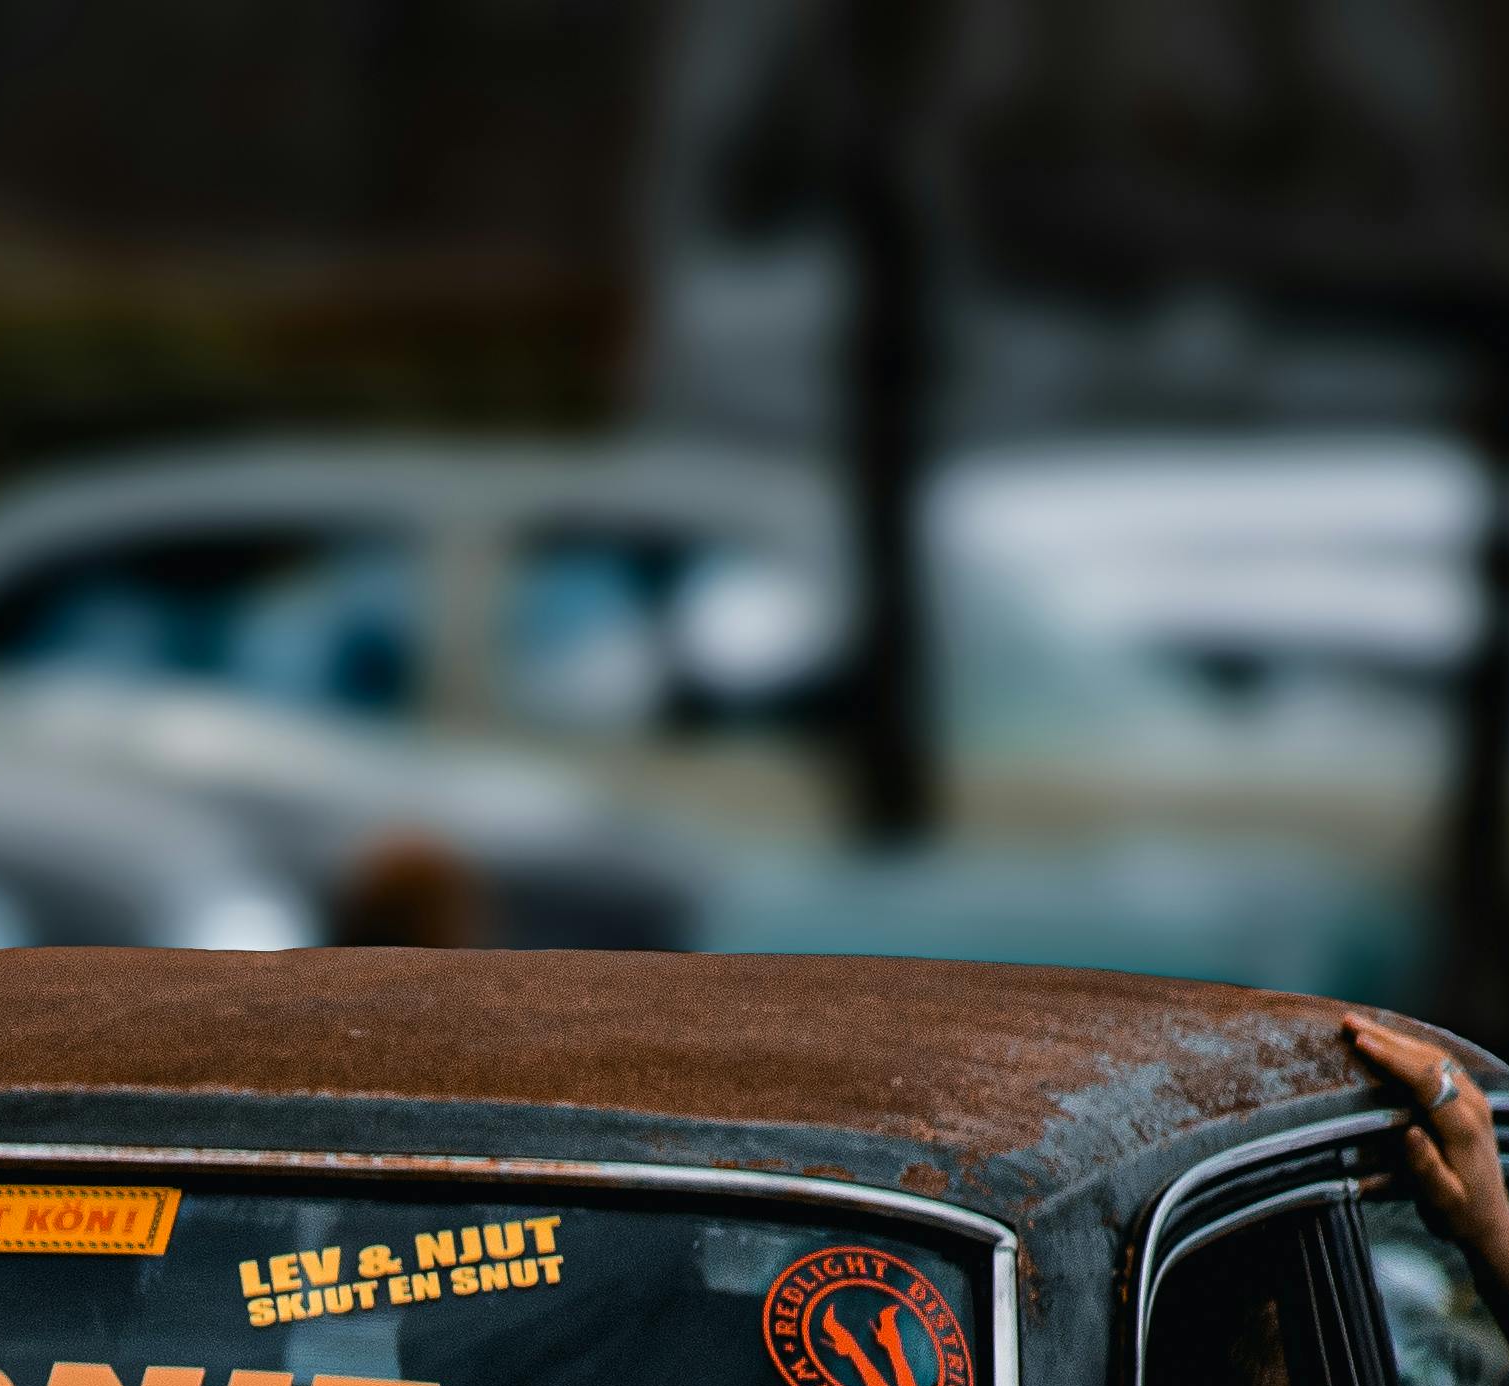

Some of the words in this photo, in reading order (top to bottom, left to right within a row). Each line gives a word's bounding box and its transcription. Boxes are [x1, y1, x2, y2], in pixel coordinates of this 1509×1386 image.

[23, 1199, 140, 1234] KÖN!
[238, 1246, 341, 1298] LEV
[357, 1244, 404, 1278] &
[414, 1215, 562, 1270] NJUT
[246, 1280, 378, 1327] SKJUT
[387, 1272, 442, 1304] EN
[450, 1255, 564, 1296] SNUT
[774, 1256, 889, 1337] REDLIGHT
